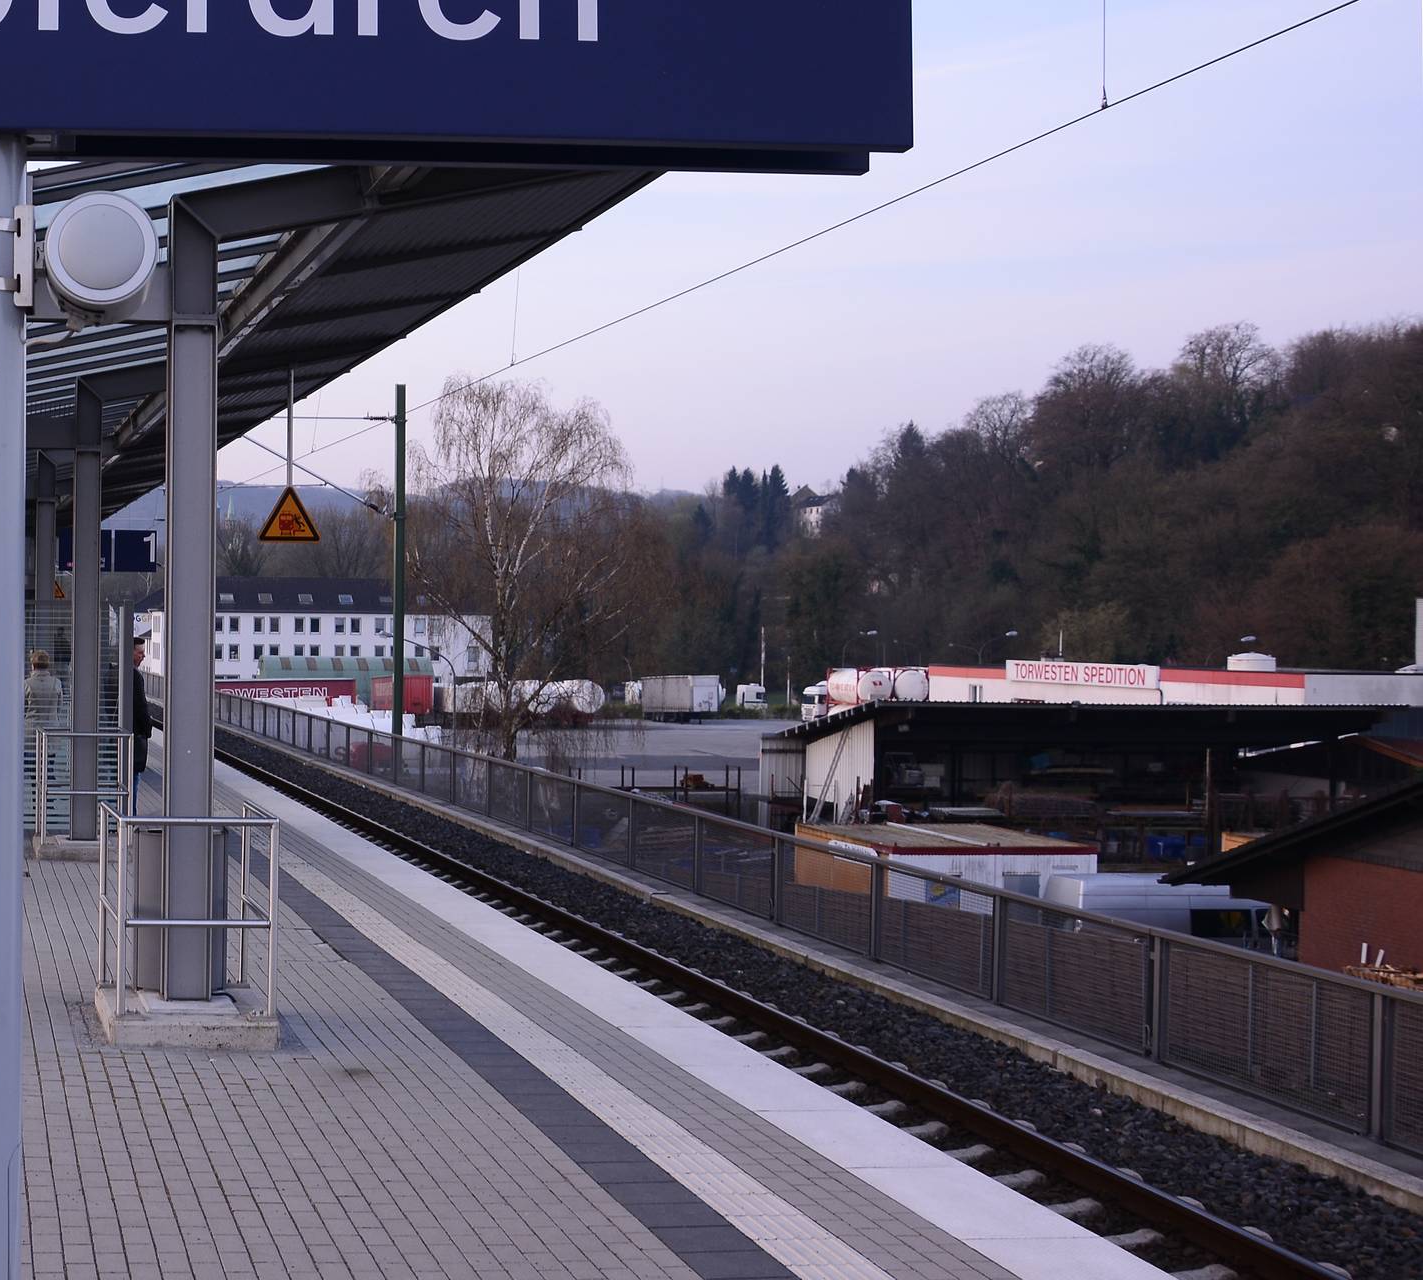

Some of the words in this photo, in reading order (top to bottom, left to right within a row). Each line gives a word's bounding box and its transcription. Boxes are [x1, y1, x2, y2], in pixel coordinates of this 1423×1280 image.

[143, 532, 156, 563] 1
[1014, 663, 1079, 681] TORWESTEN
[1083, 665, 1146, 686] SPEDITION
